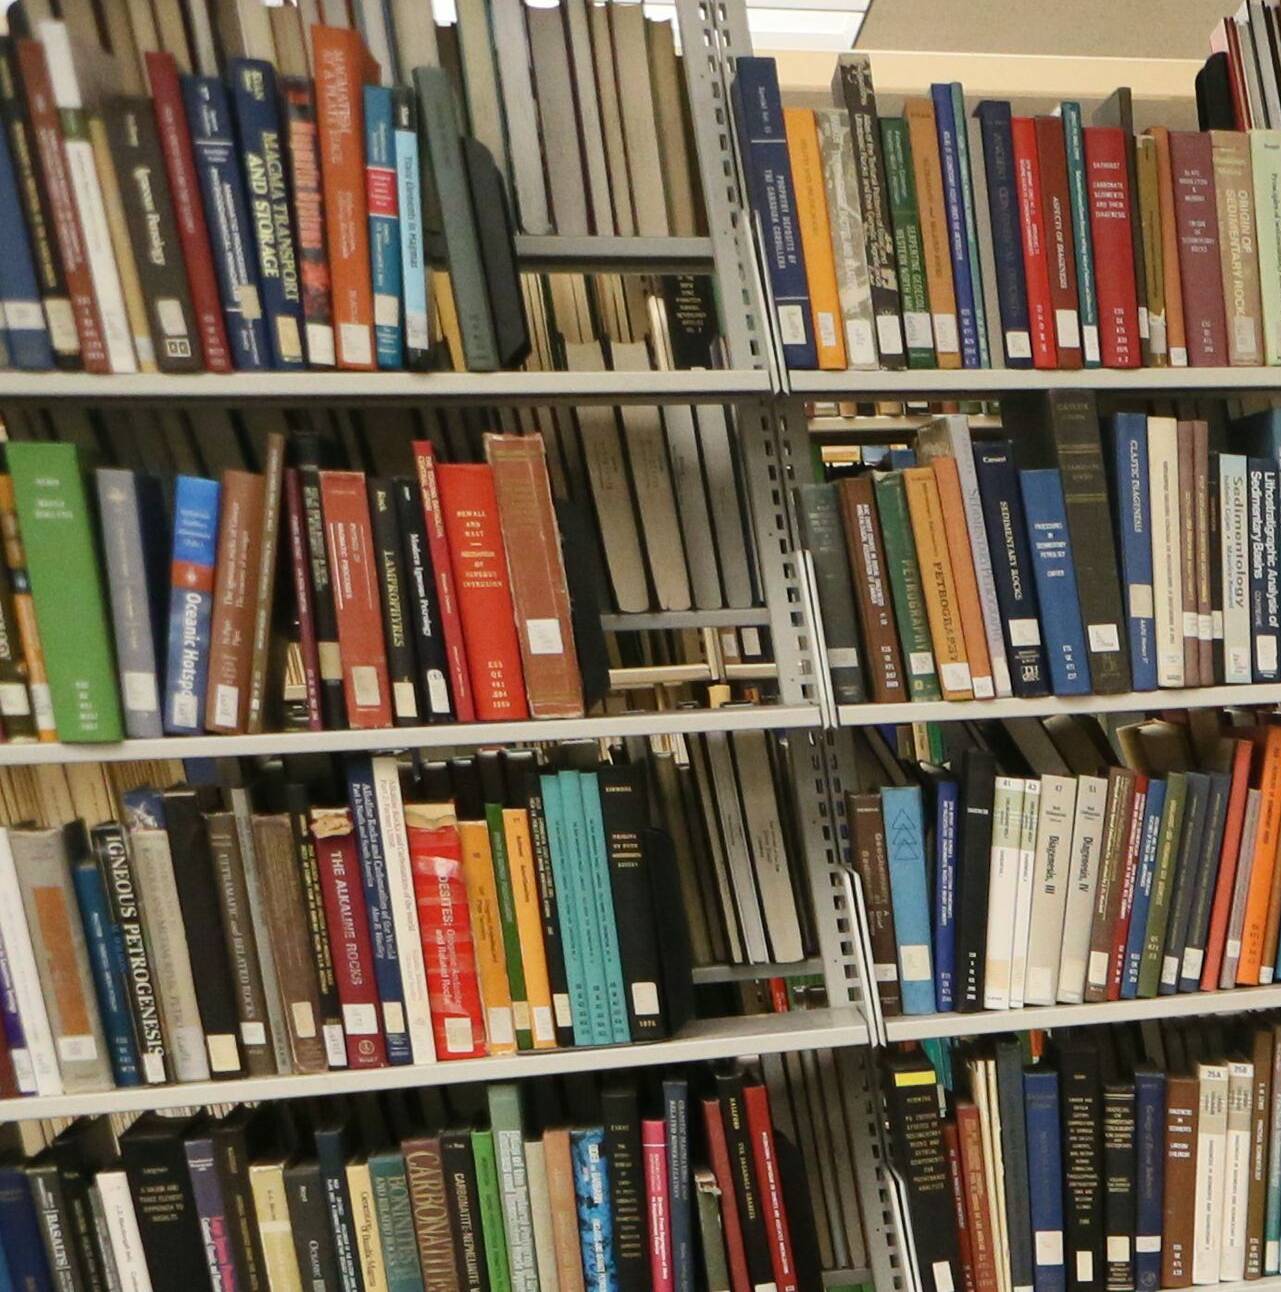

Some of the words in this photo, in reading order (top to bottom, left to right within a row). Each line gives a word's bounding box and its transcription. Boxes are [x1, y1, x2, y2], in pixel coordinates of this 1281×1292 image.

[247, 154, 267, 193] AND
[262, 131, 284, 200] MAGMA
[1226, 189, 1242, 278] SEDIMENTARY
[1237, 189, 1251, 234] ORIGIN
[253, 201, 279, 279] STORAGE
[269, 203, 299, 302] TRANSPORT
[1241, 236, 1253, 253] OF
[1233, 280, 1246, 317] ROCK
[1250, 471, 1262, 540] Sedimentary
[1264, 471, 1277, 566] Lithostratigraphic
[1000, 501, 1019, 566] SEDIMENTARY
[1011, 569, 1023, 600] ROCKS
[1232, 475, 1247, 608] Sedimentology
[1253, 542, 1263, 578] Basins
[384, 551, 404, 646] LAMPROPHYRES
[410, 534, 422, 565] Modern
[416, 599, 432, 636] Petrology
[902, 560, 926, 650] PETROGRAPHY
[1266, 569, 1278, 613] Analysis
[185, 592, 203, 646] Oceanic
[935, 562, 959, 661] PETROGRAPHY
[1268, 615, 1279, 627] of
[180, 650, 200, 698] Hotspo
[363, 783, 375, 817] Alkaline
[368, 819, 378, 842] Rocks
[371, 844, 381, 859] and
[330, 850, 345, 876] THE
[1045, 835, 1060, 881] Diagenesis,
[1079, 836, 1093, 881] Diagenesis,
[336, 880, 356, 938] ALKALINE
[104, 836, 135, 917] IGNEOUS
[124, 924, 164, 1057] PETROGENESIS
[344, 942, 362, 985] ROCKS
[46, 1213, 69, 1265] BASALTS
